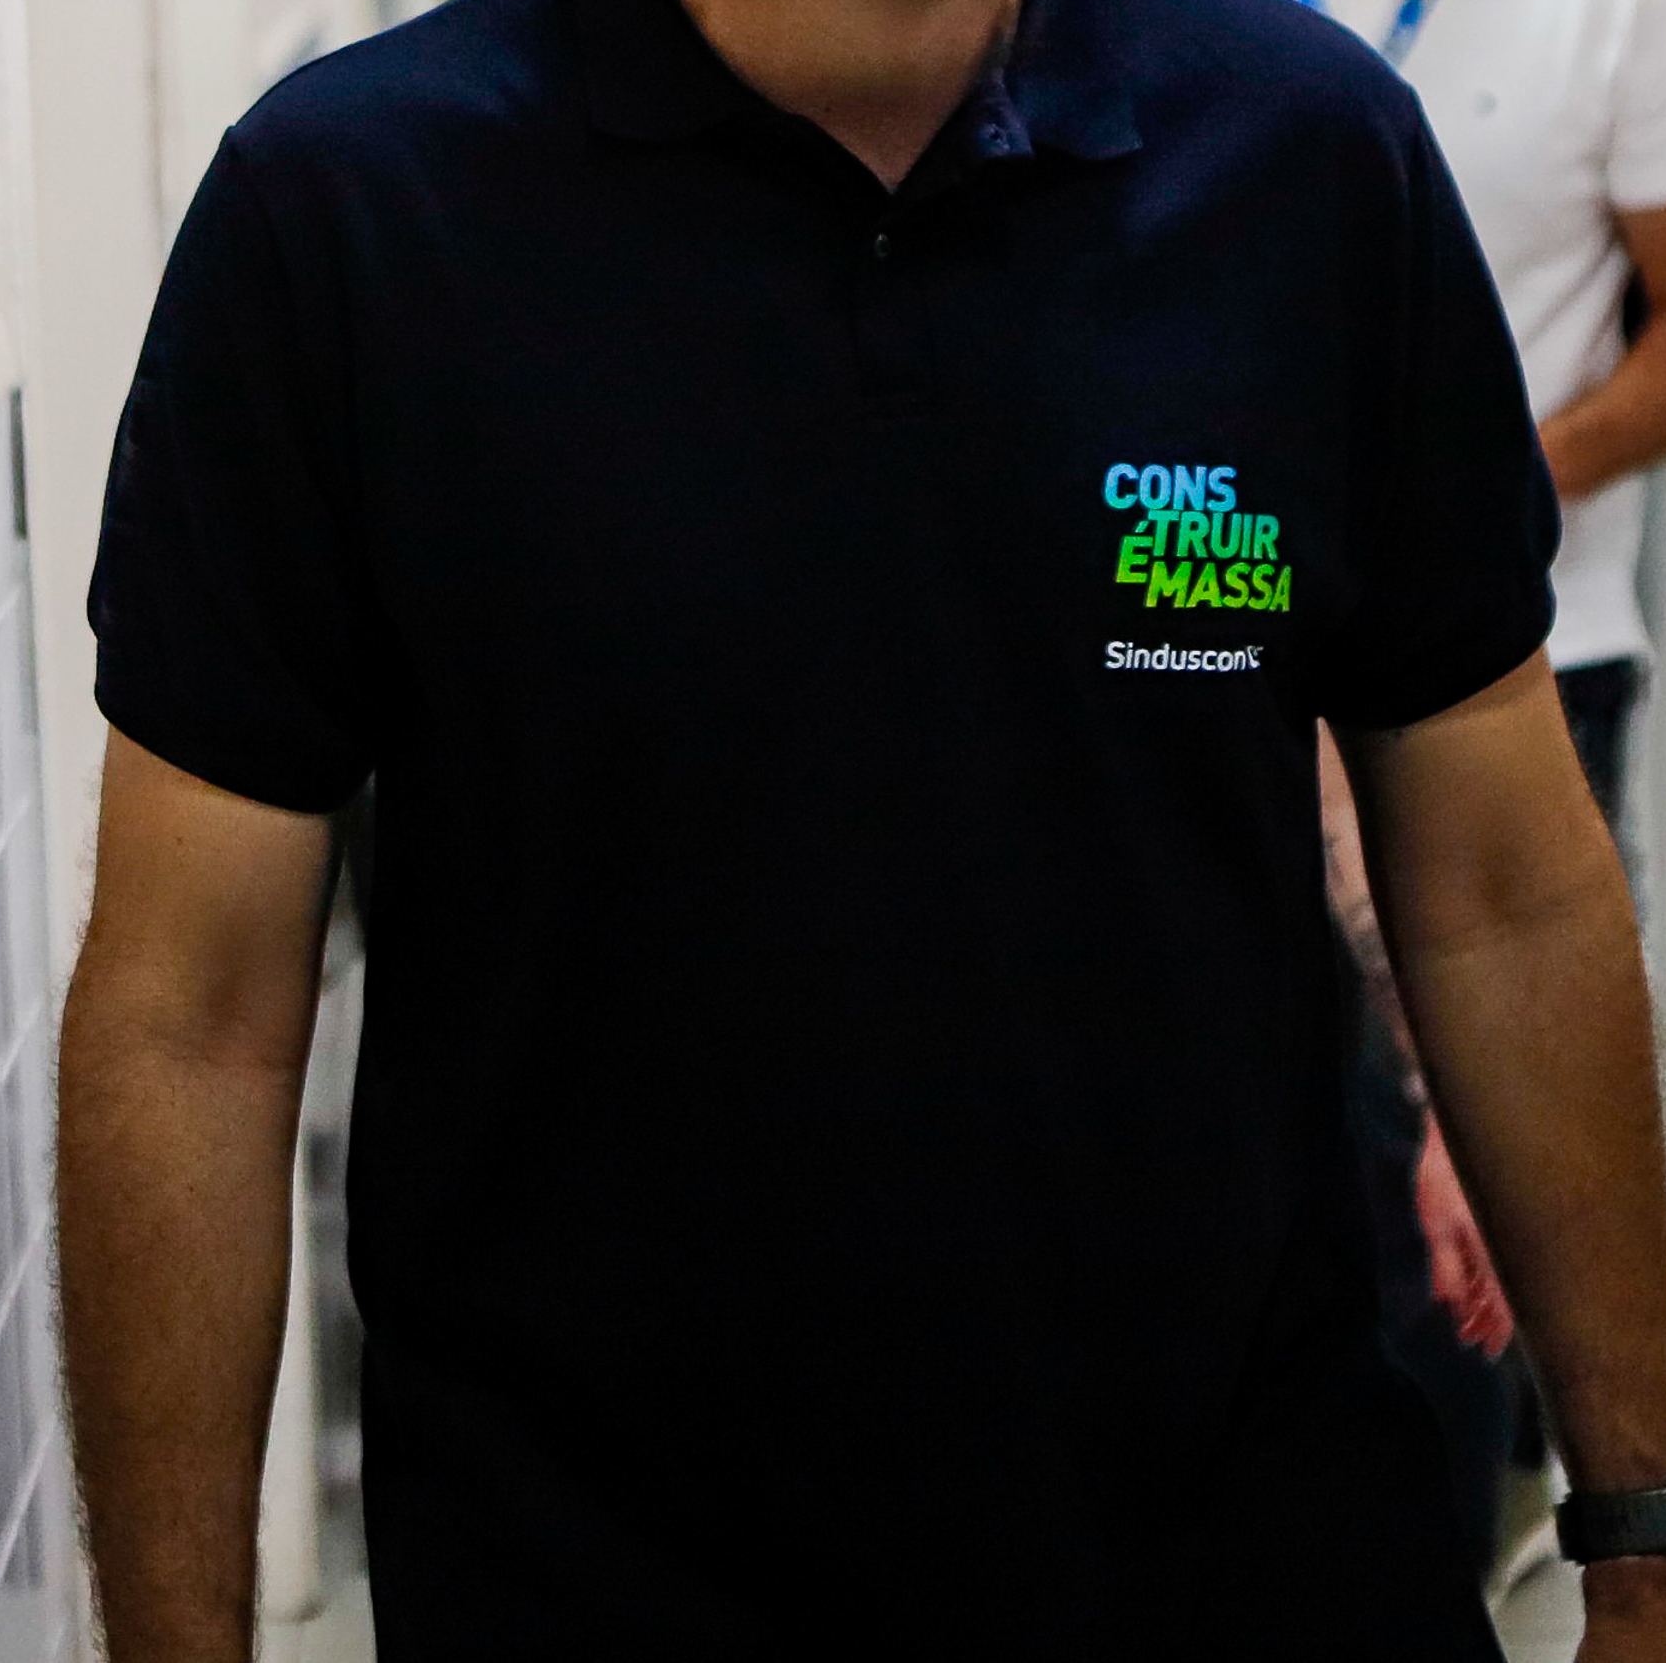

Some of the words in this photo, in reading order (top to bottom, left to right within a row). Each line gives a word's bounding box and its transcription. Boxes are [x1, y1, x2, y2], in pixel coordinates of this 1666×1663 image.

[1103, 462, 1237, 512] CONS
[1148, 509, 1281, 561] TRUIR
[1144, 559, 1292, 613] MASSA
